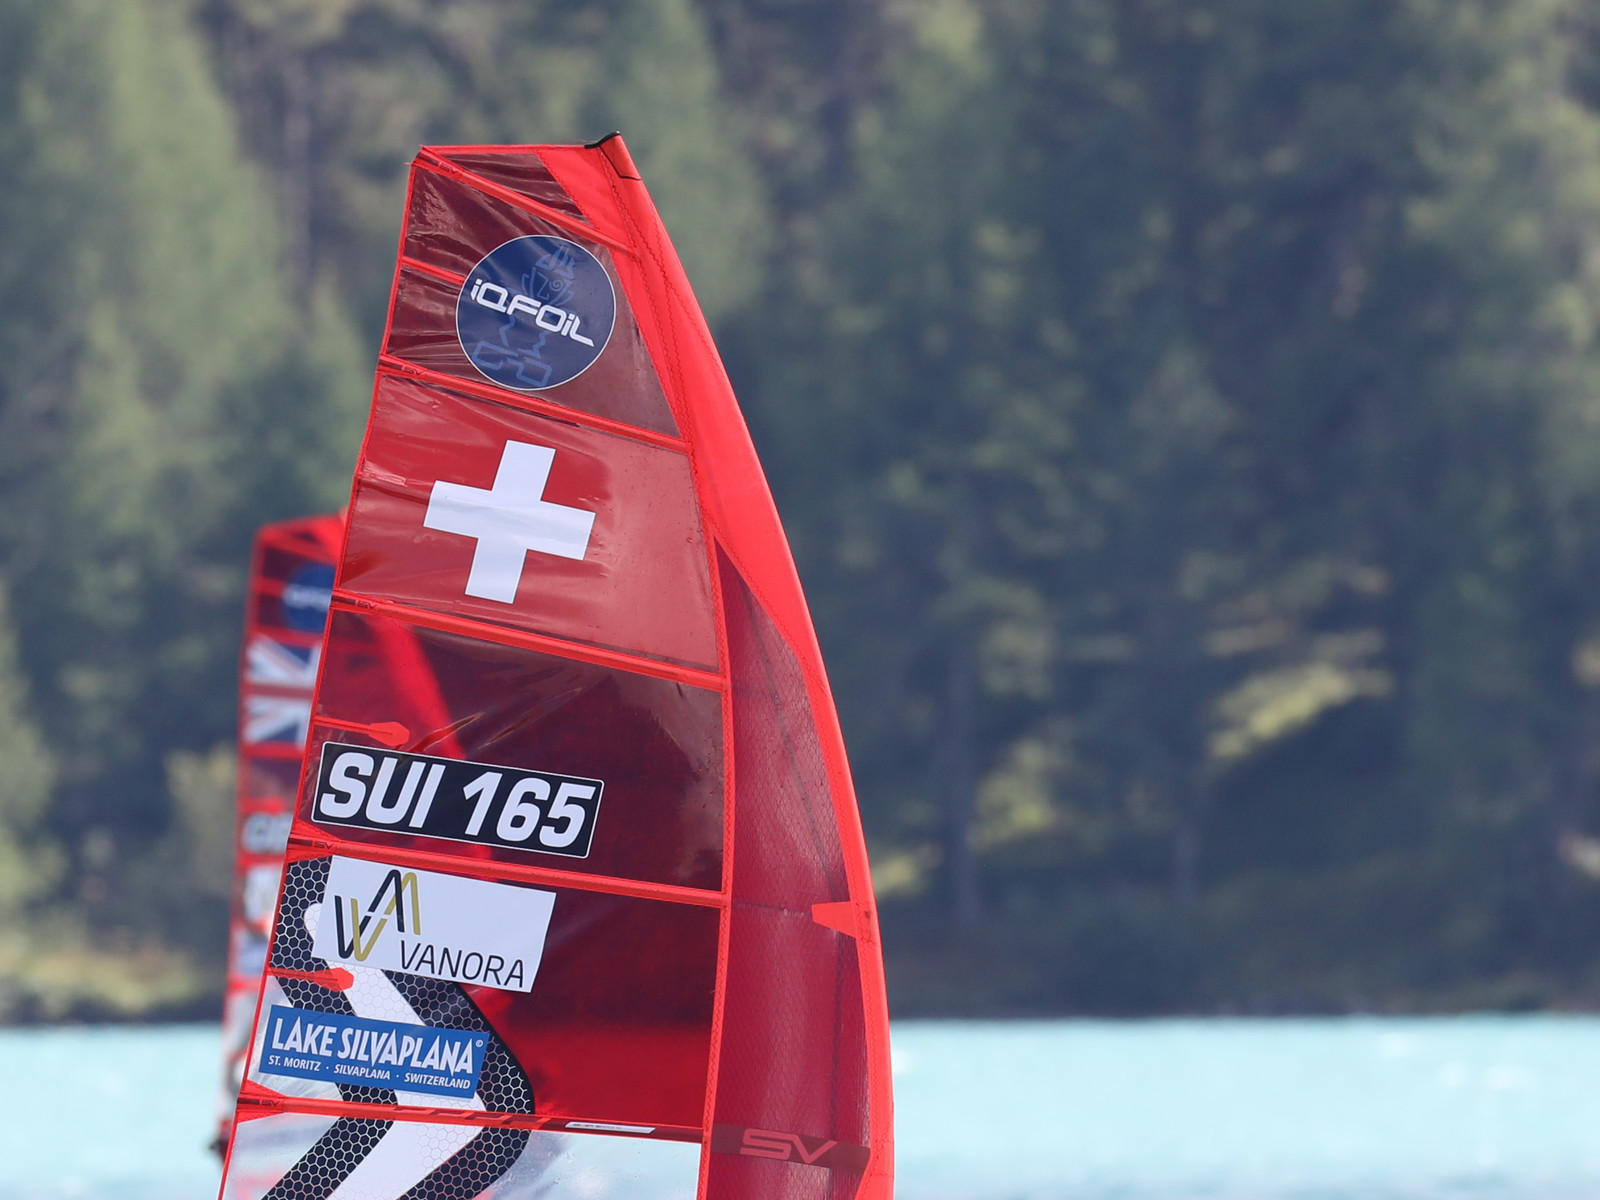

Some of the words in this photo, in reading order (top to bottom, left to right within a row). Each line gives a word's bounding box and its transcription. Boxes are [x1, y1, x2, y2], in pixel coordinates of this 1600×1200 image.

[319, 751, 446, 828] SUI
[462, 771, 597, 848] 165
[400, 939, 525, 988] VANORA
[271, 1016, 337, 1057] LAKE
[268, 1054, 281, 1067] ST.
[283, 1057, 322, 1072] MORITZ
[333, 1063, 391, 1080] SILVAPLANA
[404, 1072, 471, 1090] SWITZERLAND
[740, 1128, 838, 1164] SV
